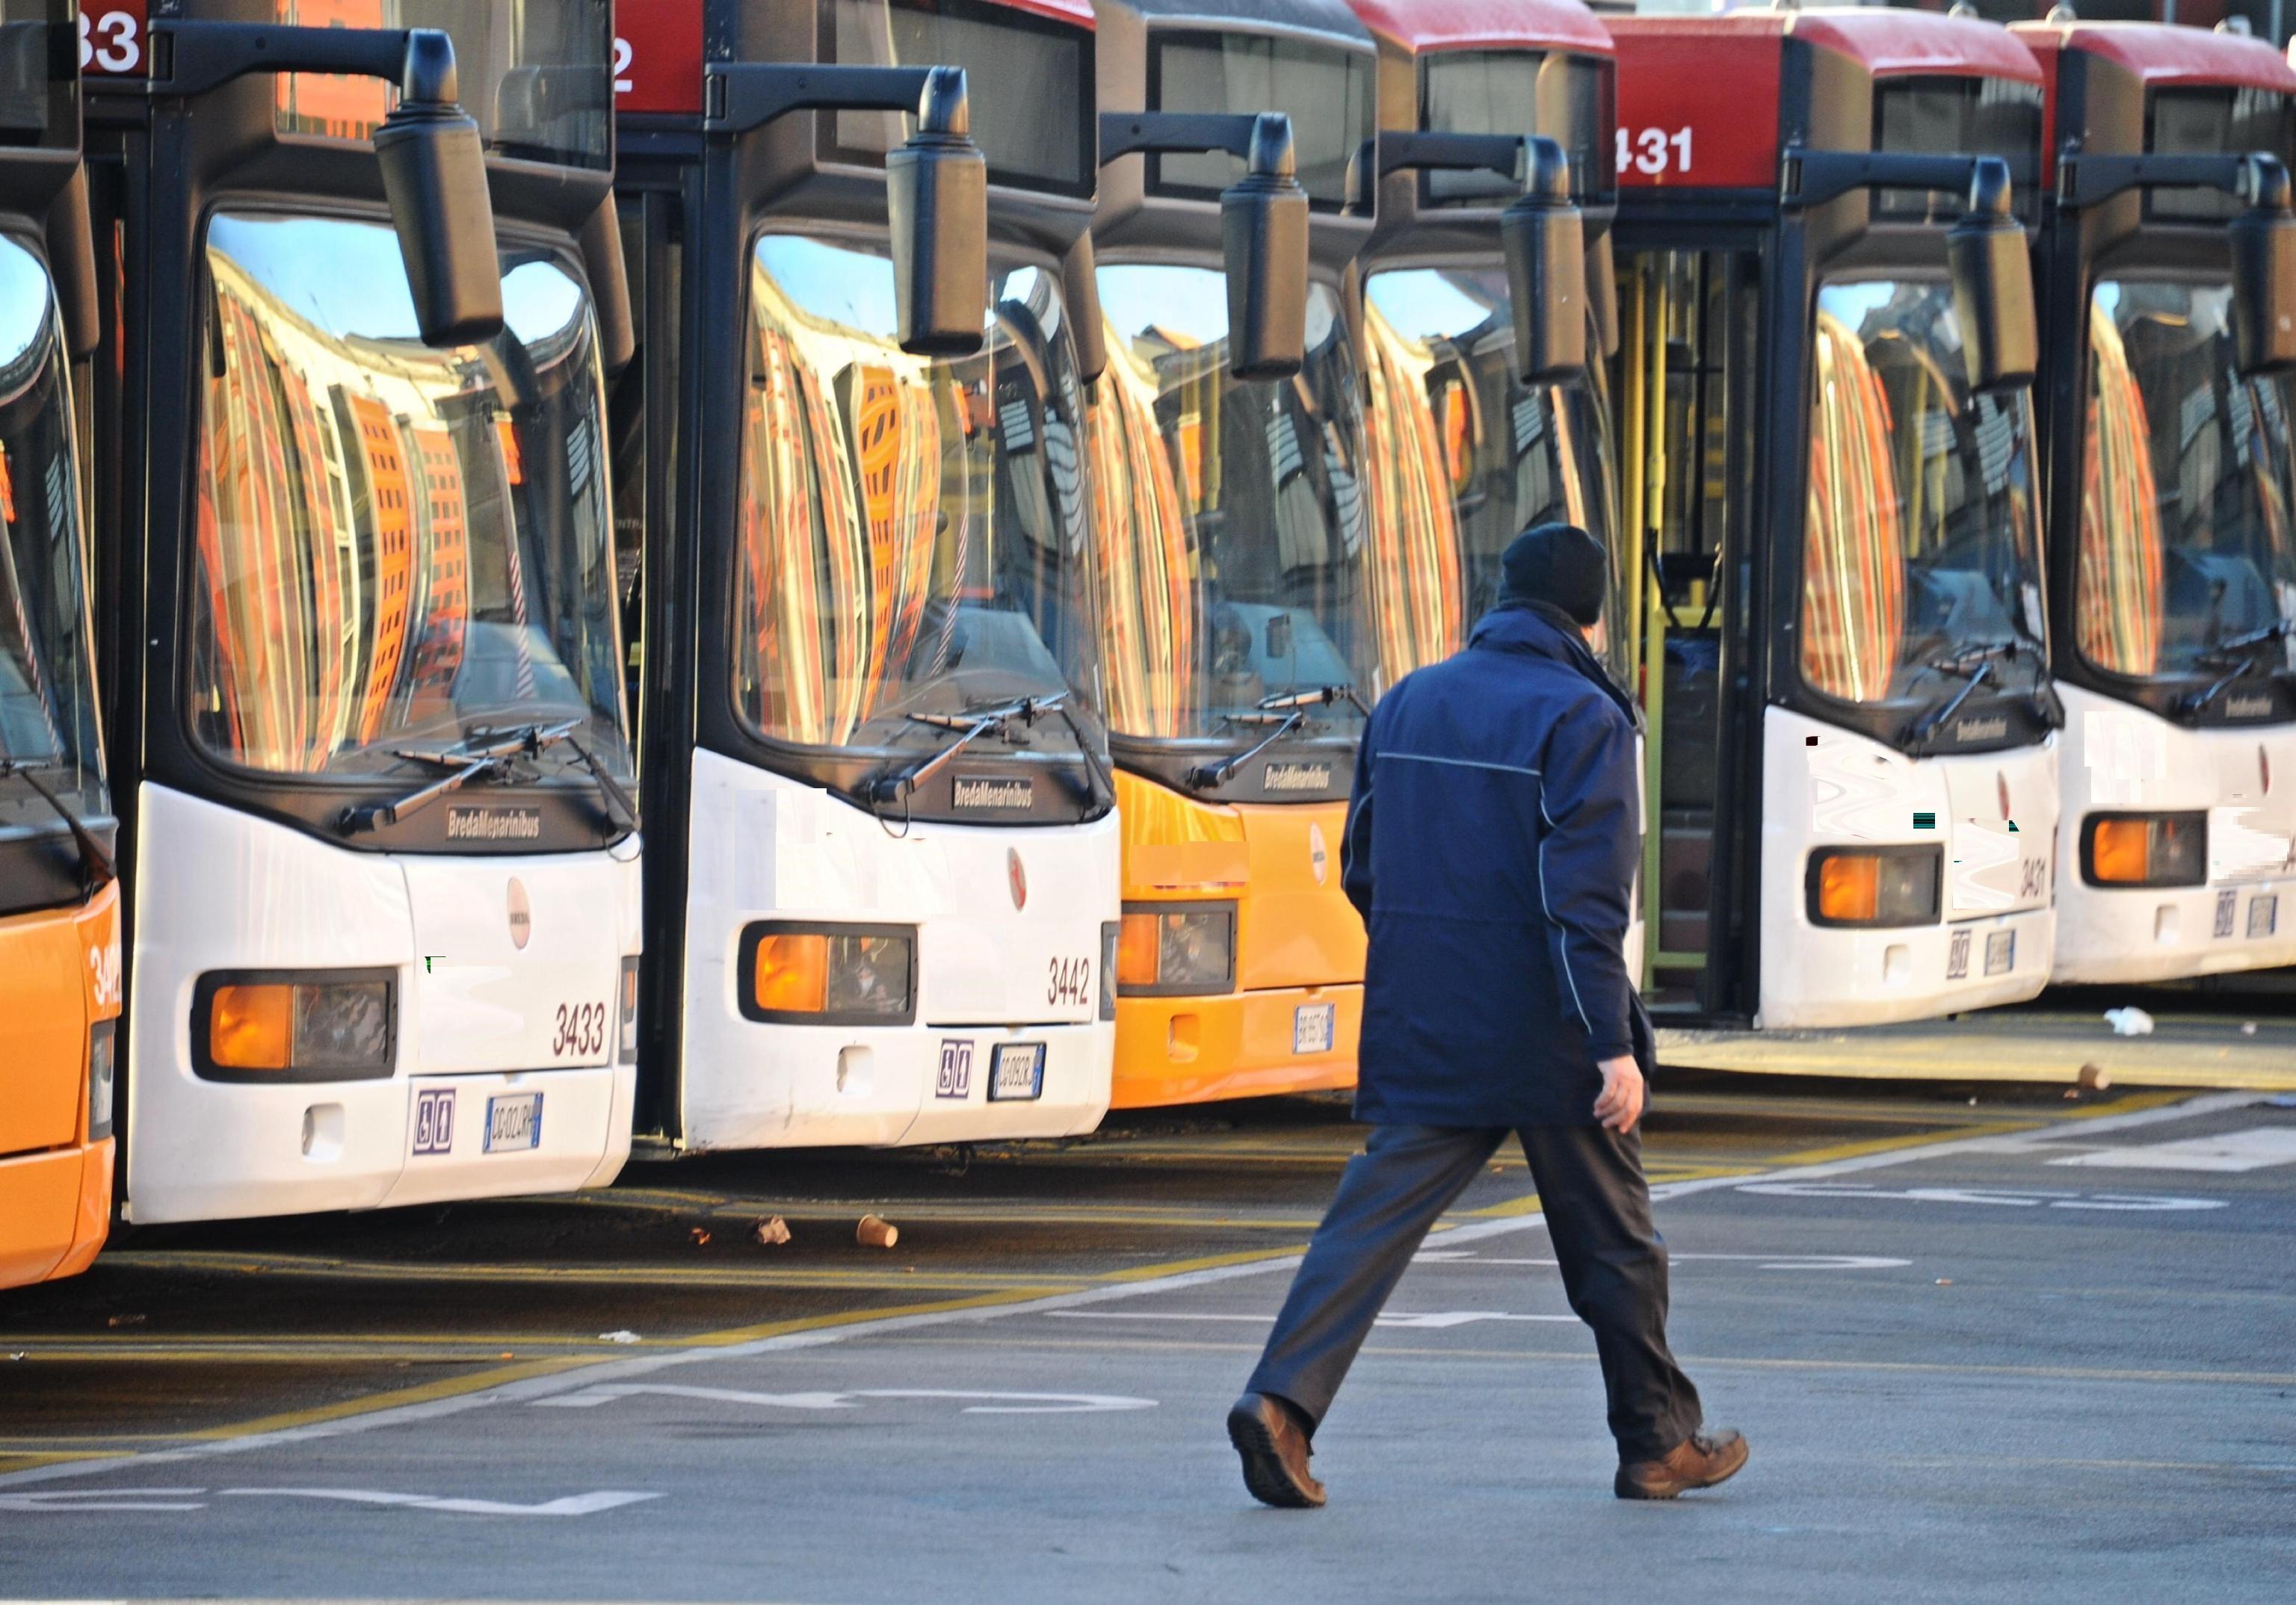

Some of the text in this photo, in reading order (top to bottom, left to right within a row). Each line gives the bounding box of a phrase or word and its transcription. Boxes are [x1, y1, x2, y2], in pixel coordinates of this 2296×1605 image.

[954, 780, 1032, 808] BredaMenarinibus
[448, 809, 540, 838] BredaMenarinibus
[1048, 956, 1089, 1006] 3442
[553, 1001, 605, 1057] 3433
